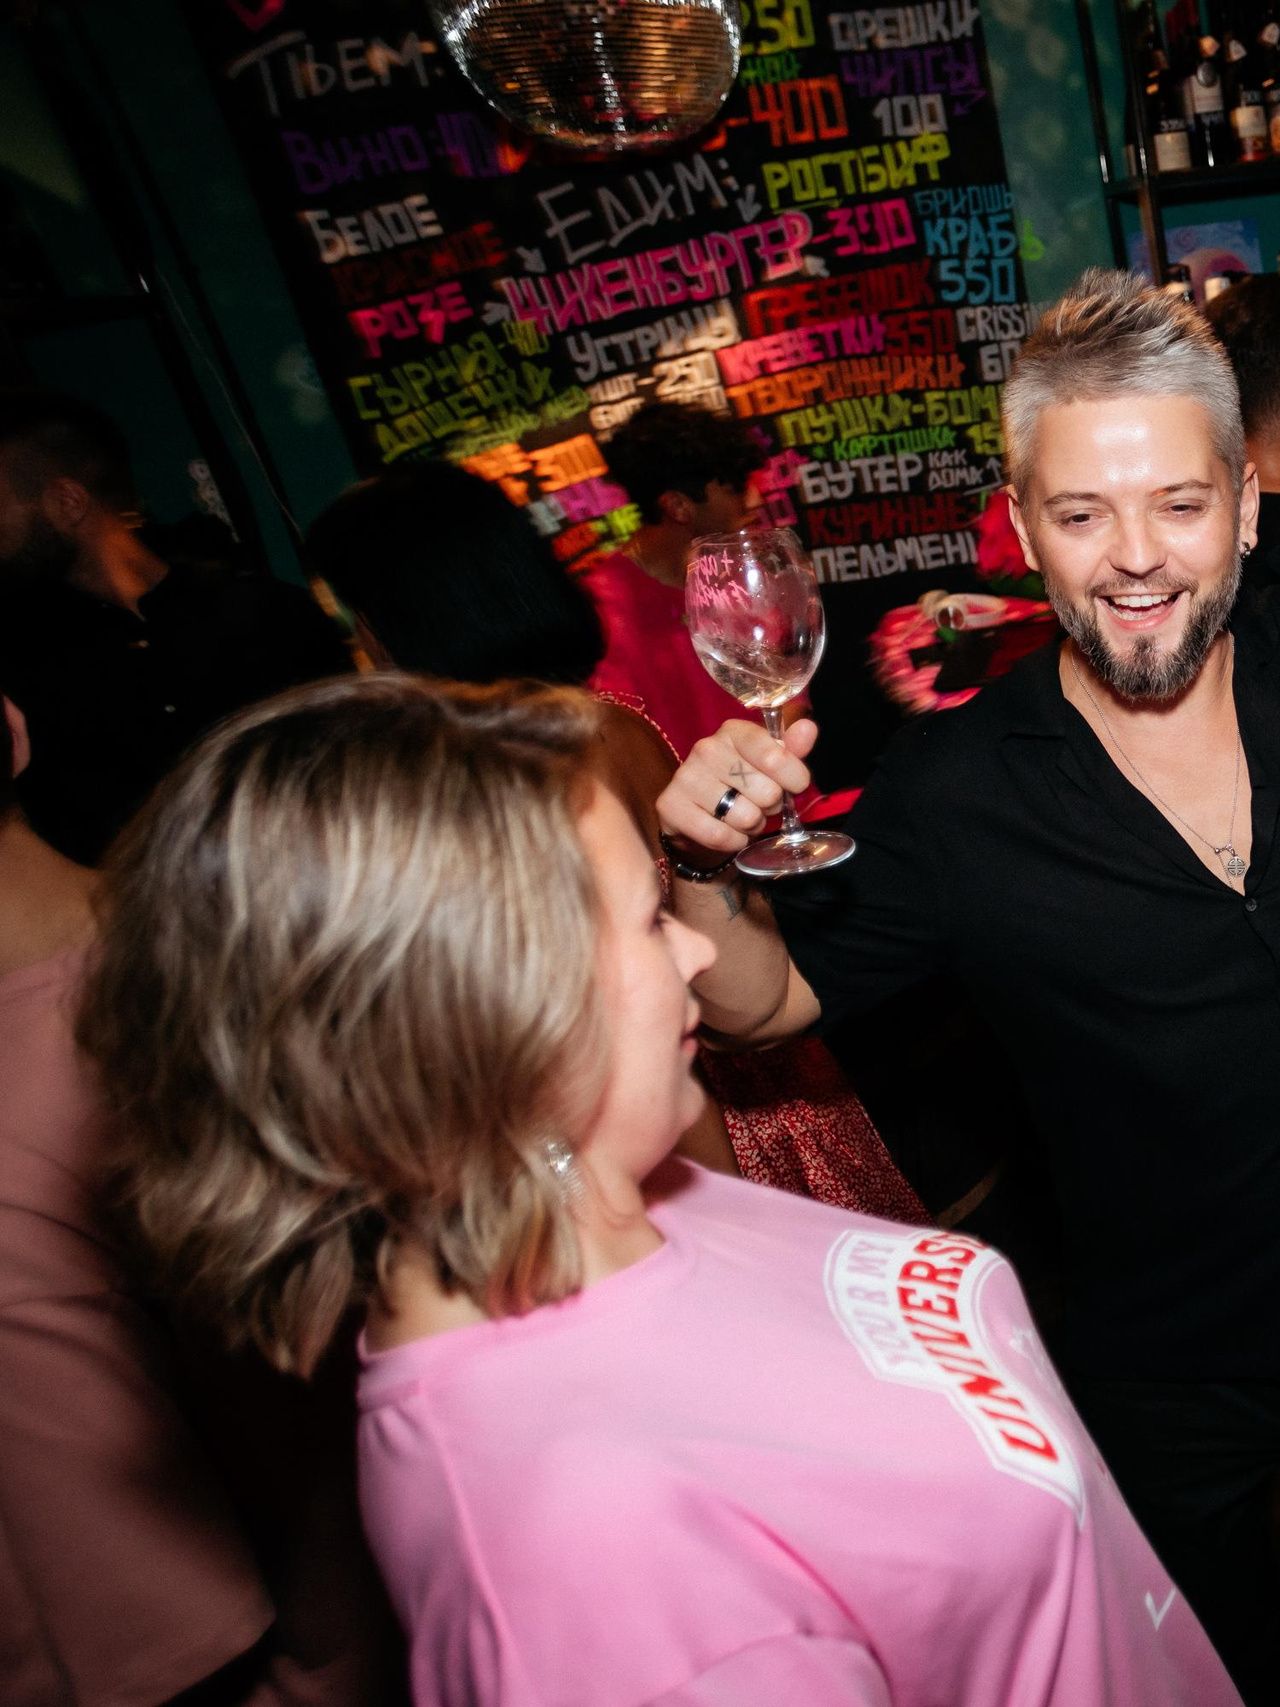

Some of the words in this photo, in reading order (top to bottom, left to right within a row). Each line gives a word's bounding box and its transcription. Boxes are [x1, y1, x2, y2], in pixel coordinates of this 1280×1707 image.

[828, 0, 980, 51] ОРЕШКИ
[840, 43, 980, 97] ЧИПСЫ
[873, 93, 948, 137] 100
[761, 131, 951, 208] РОСТБИФ
[914, 183, 1015, 218] БРИОШЬ
[296, 193, 444, 264] БЕЛОЕ
[923, 212, 1017, 258] КРАБ
[939, 257, 1017, 305] 550
[347, 280, 475, 359] РОЗЕ
[716, 313, 887, 386] КРЕВЕТКИ
[883, 308, 956, 355] 350
[727, 353, 967, 418] ТВОРОЖНИКИ
[777, 384, 1003, 446] ПУШКА-БОМ
[833, 427, 957, 461] КАРТОШКА
[928, 448, 968, 468] КАК
[798, 453, 923, 504] БУТЕР
[928, 464, 986, 491] ДОМА
